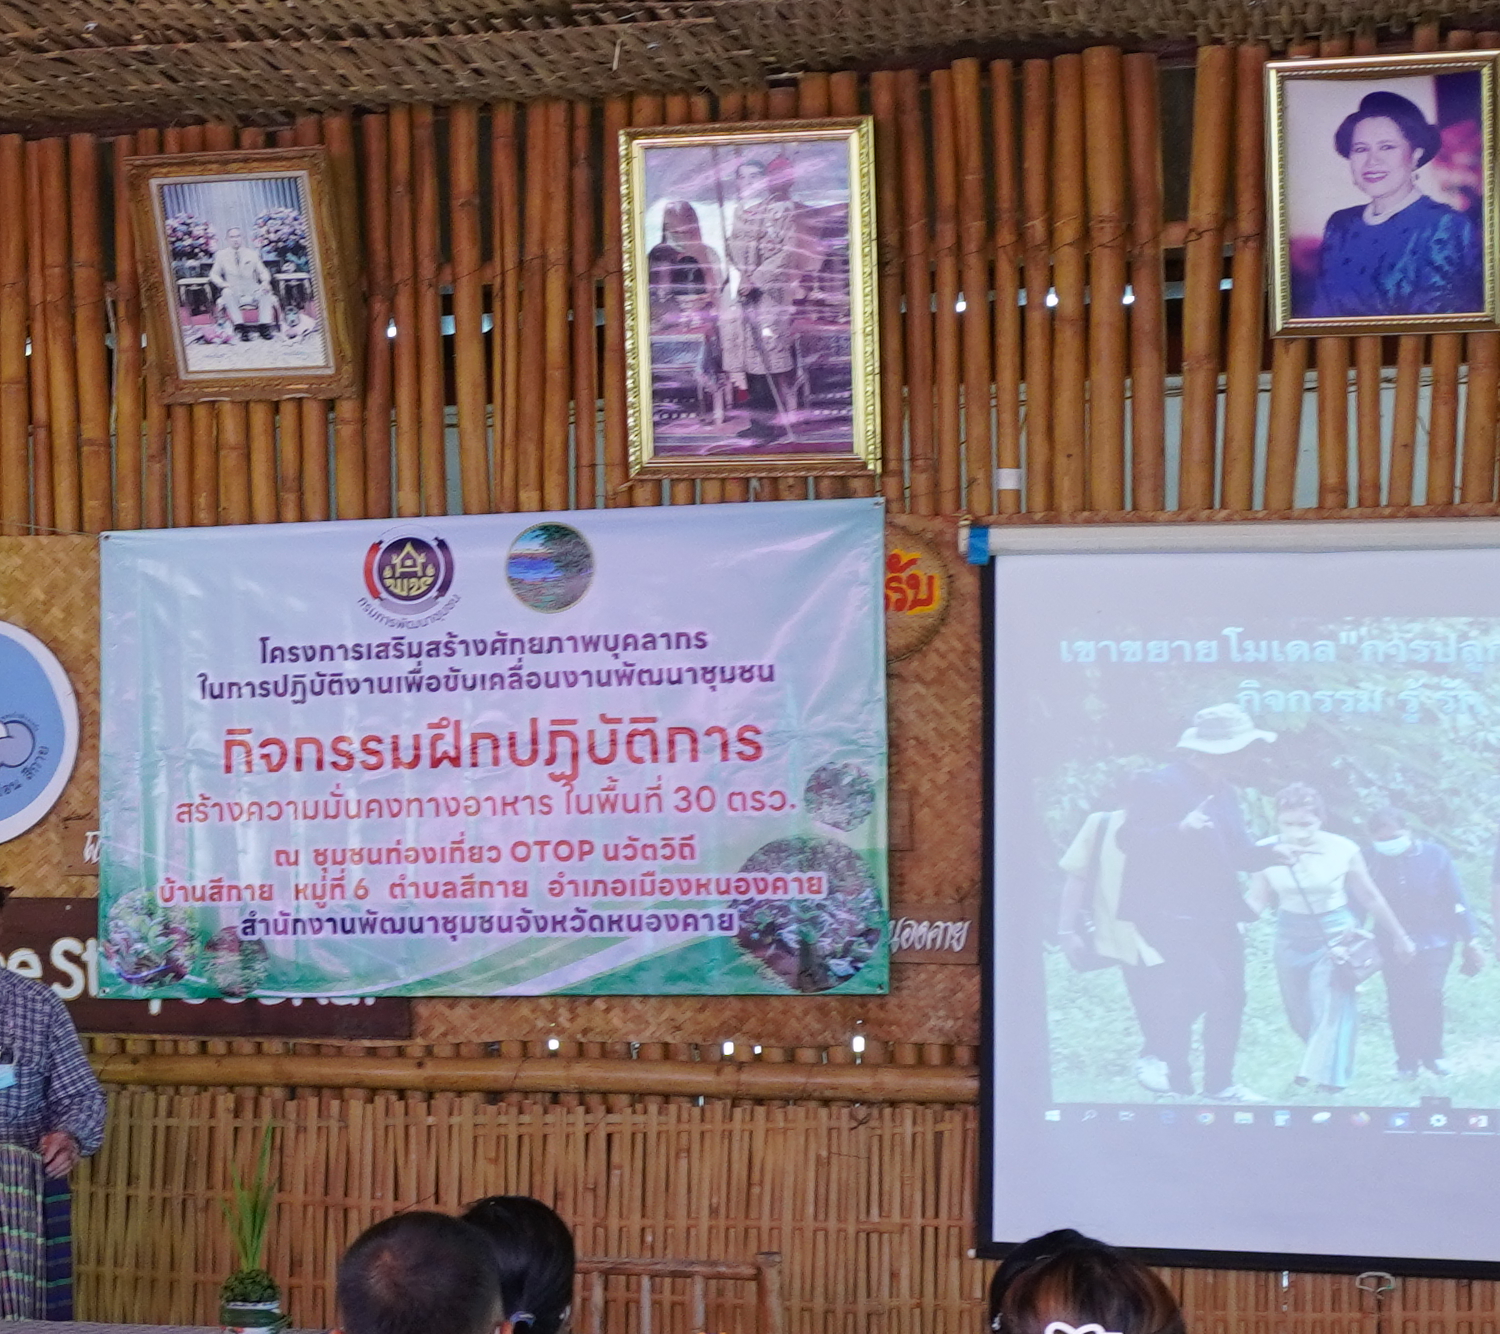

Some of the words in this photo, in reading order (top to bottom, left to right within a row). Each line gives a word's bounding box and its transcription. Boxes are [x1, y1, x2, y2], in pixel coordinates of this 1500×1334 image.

[259, 629, 709, 665] โครงการเสริมสร้างศักยภาพบุคลากร
[197, 655, 776, 704] ในการปฏิบัติงานเพื่อขับเคลื่อนงานพัฒนาชุมชน
[223, 713, 764, 783] กิจกรรมฝึกปฏิบัติการ
[176, 783, 554, 823] สร้างความมั่นคงทางอาหาร
[562, 775, 664, 815] ในพื้นที่
[674, 785, 717, 814] 30
[727, 788, 797, 813] ตรว.
[313, 830, 503, 873] ชุมชนท่องเที่ยว
[510, 839, 595, 863] OTOP
[603, 833, 697, 862] นวัตวิถี
[158, 876, 274, 904] บ้านสีกาย
[294, 867, 346, 909] หมู่ที่
[353, 877, 370, 901] 6
[388, 871, 528, 901] ตำบลสีกาย
[547, 870, 824, 899] อำเภอเมืองหนองคาย
[240, 906, 735, 942] สำนักงานพัฒนาชุมชนจังหวัดหนองคาย
